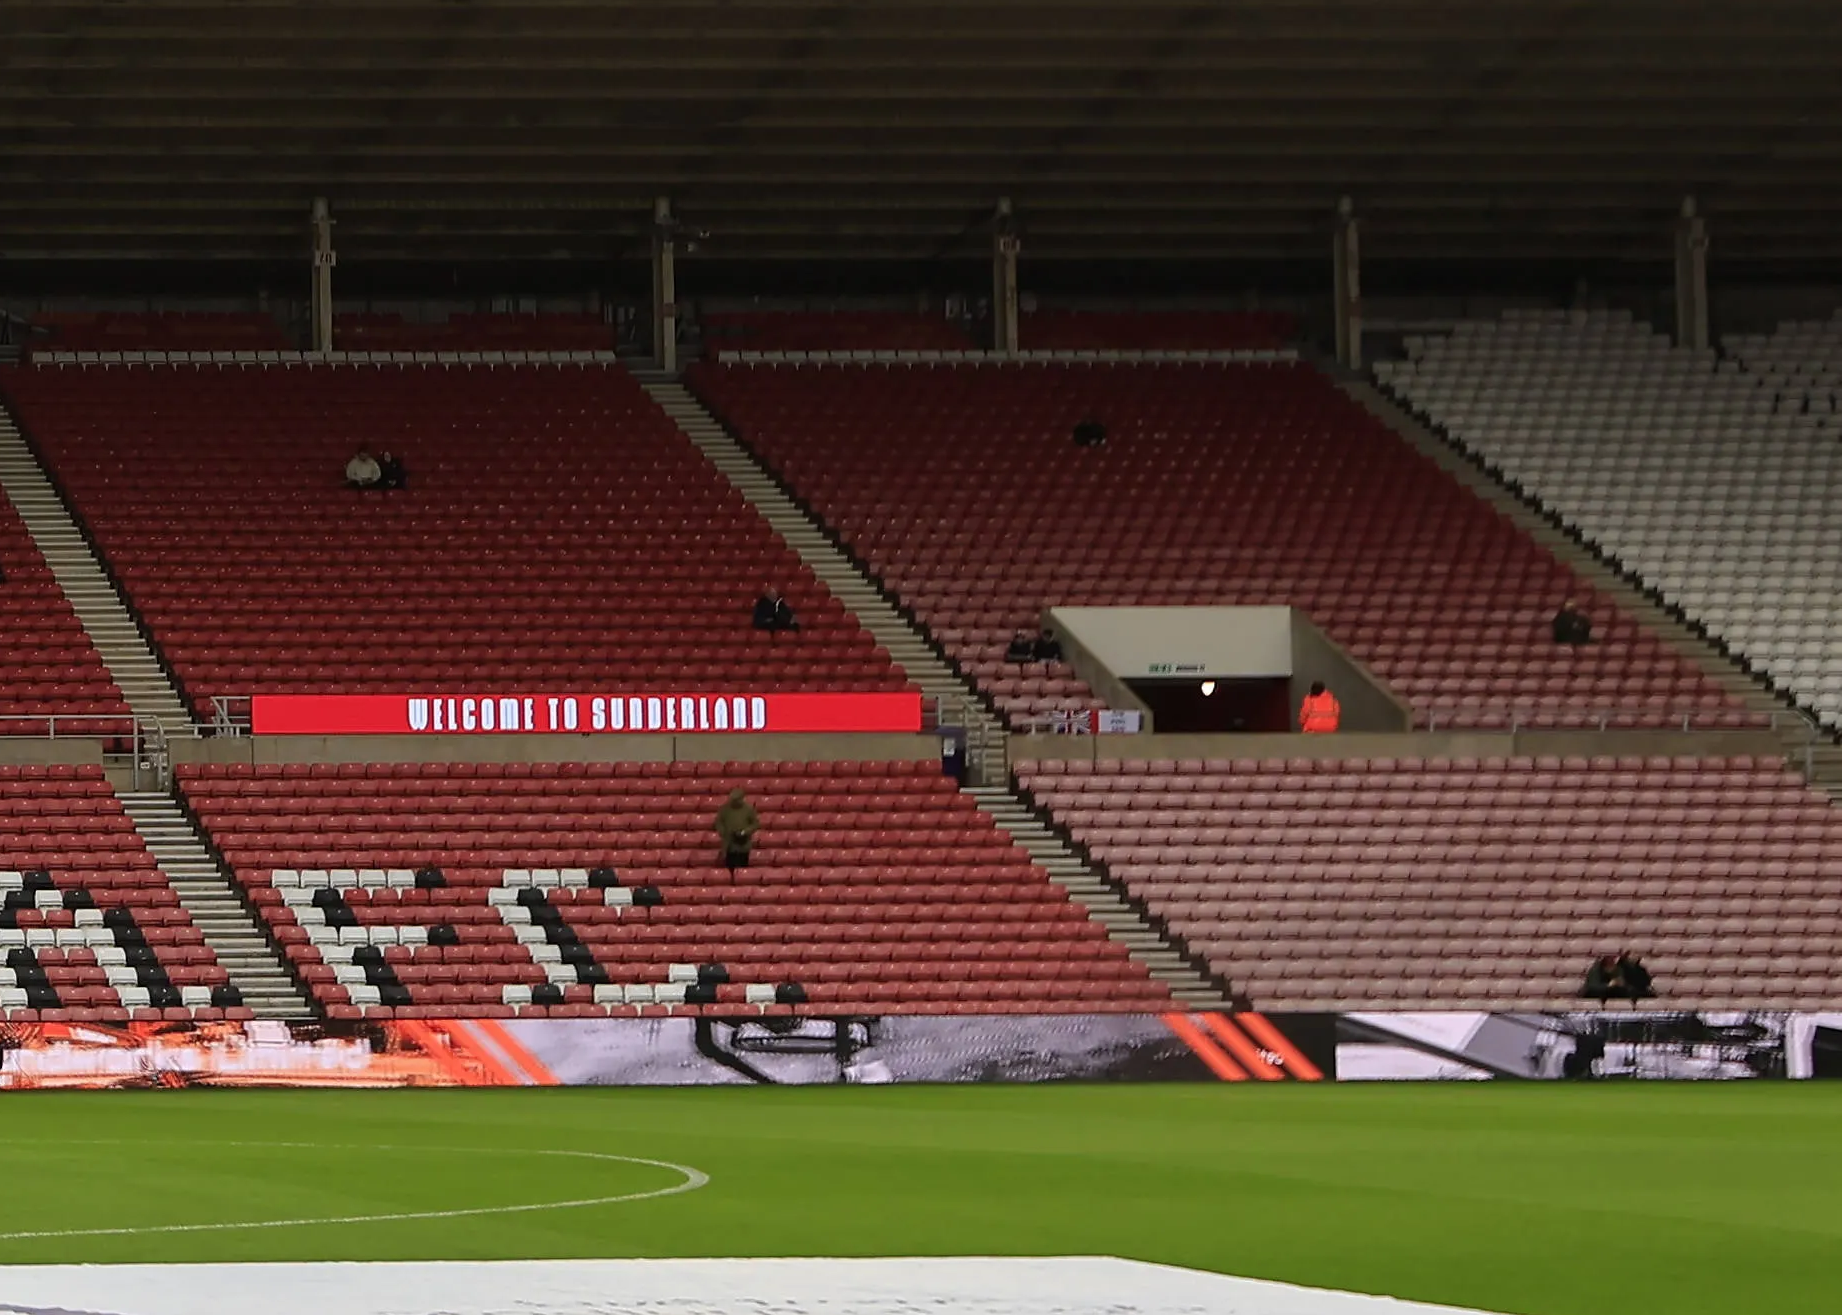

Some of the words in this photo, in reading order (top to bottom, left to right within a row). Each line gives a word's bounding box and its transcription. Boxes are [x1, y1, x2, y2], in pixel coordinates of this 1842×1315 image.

[408, 697, 534, 731] WELCOME
[547, 697, 578, 730] TO
[591, 696, 766, 730] SUNDERLAND
